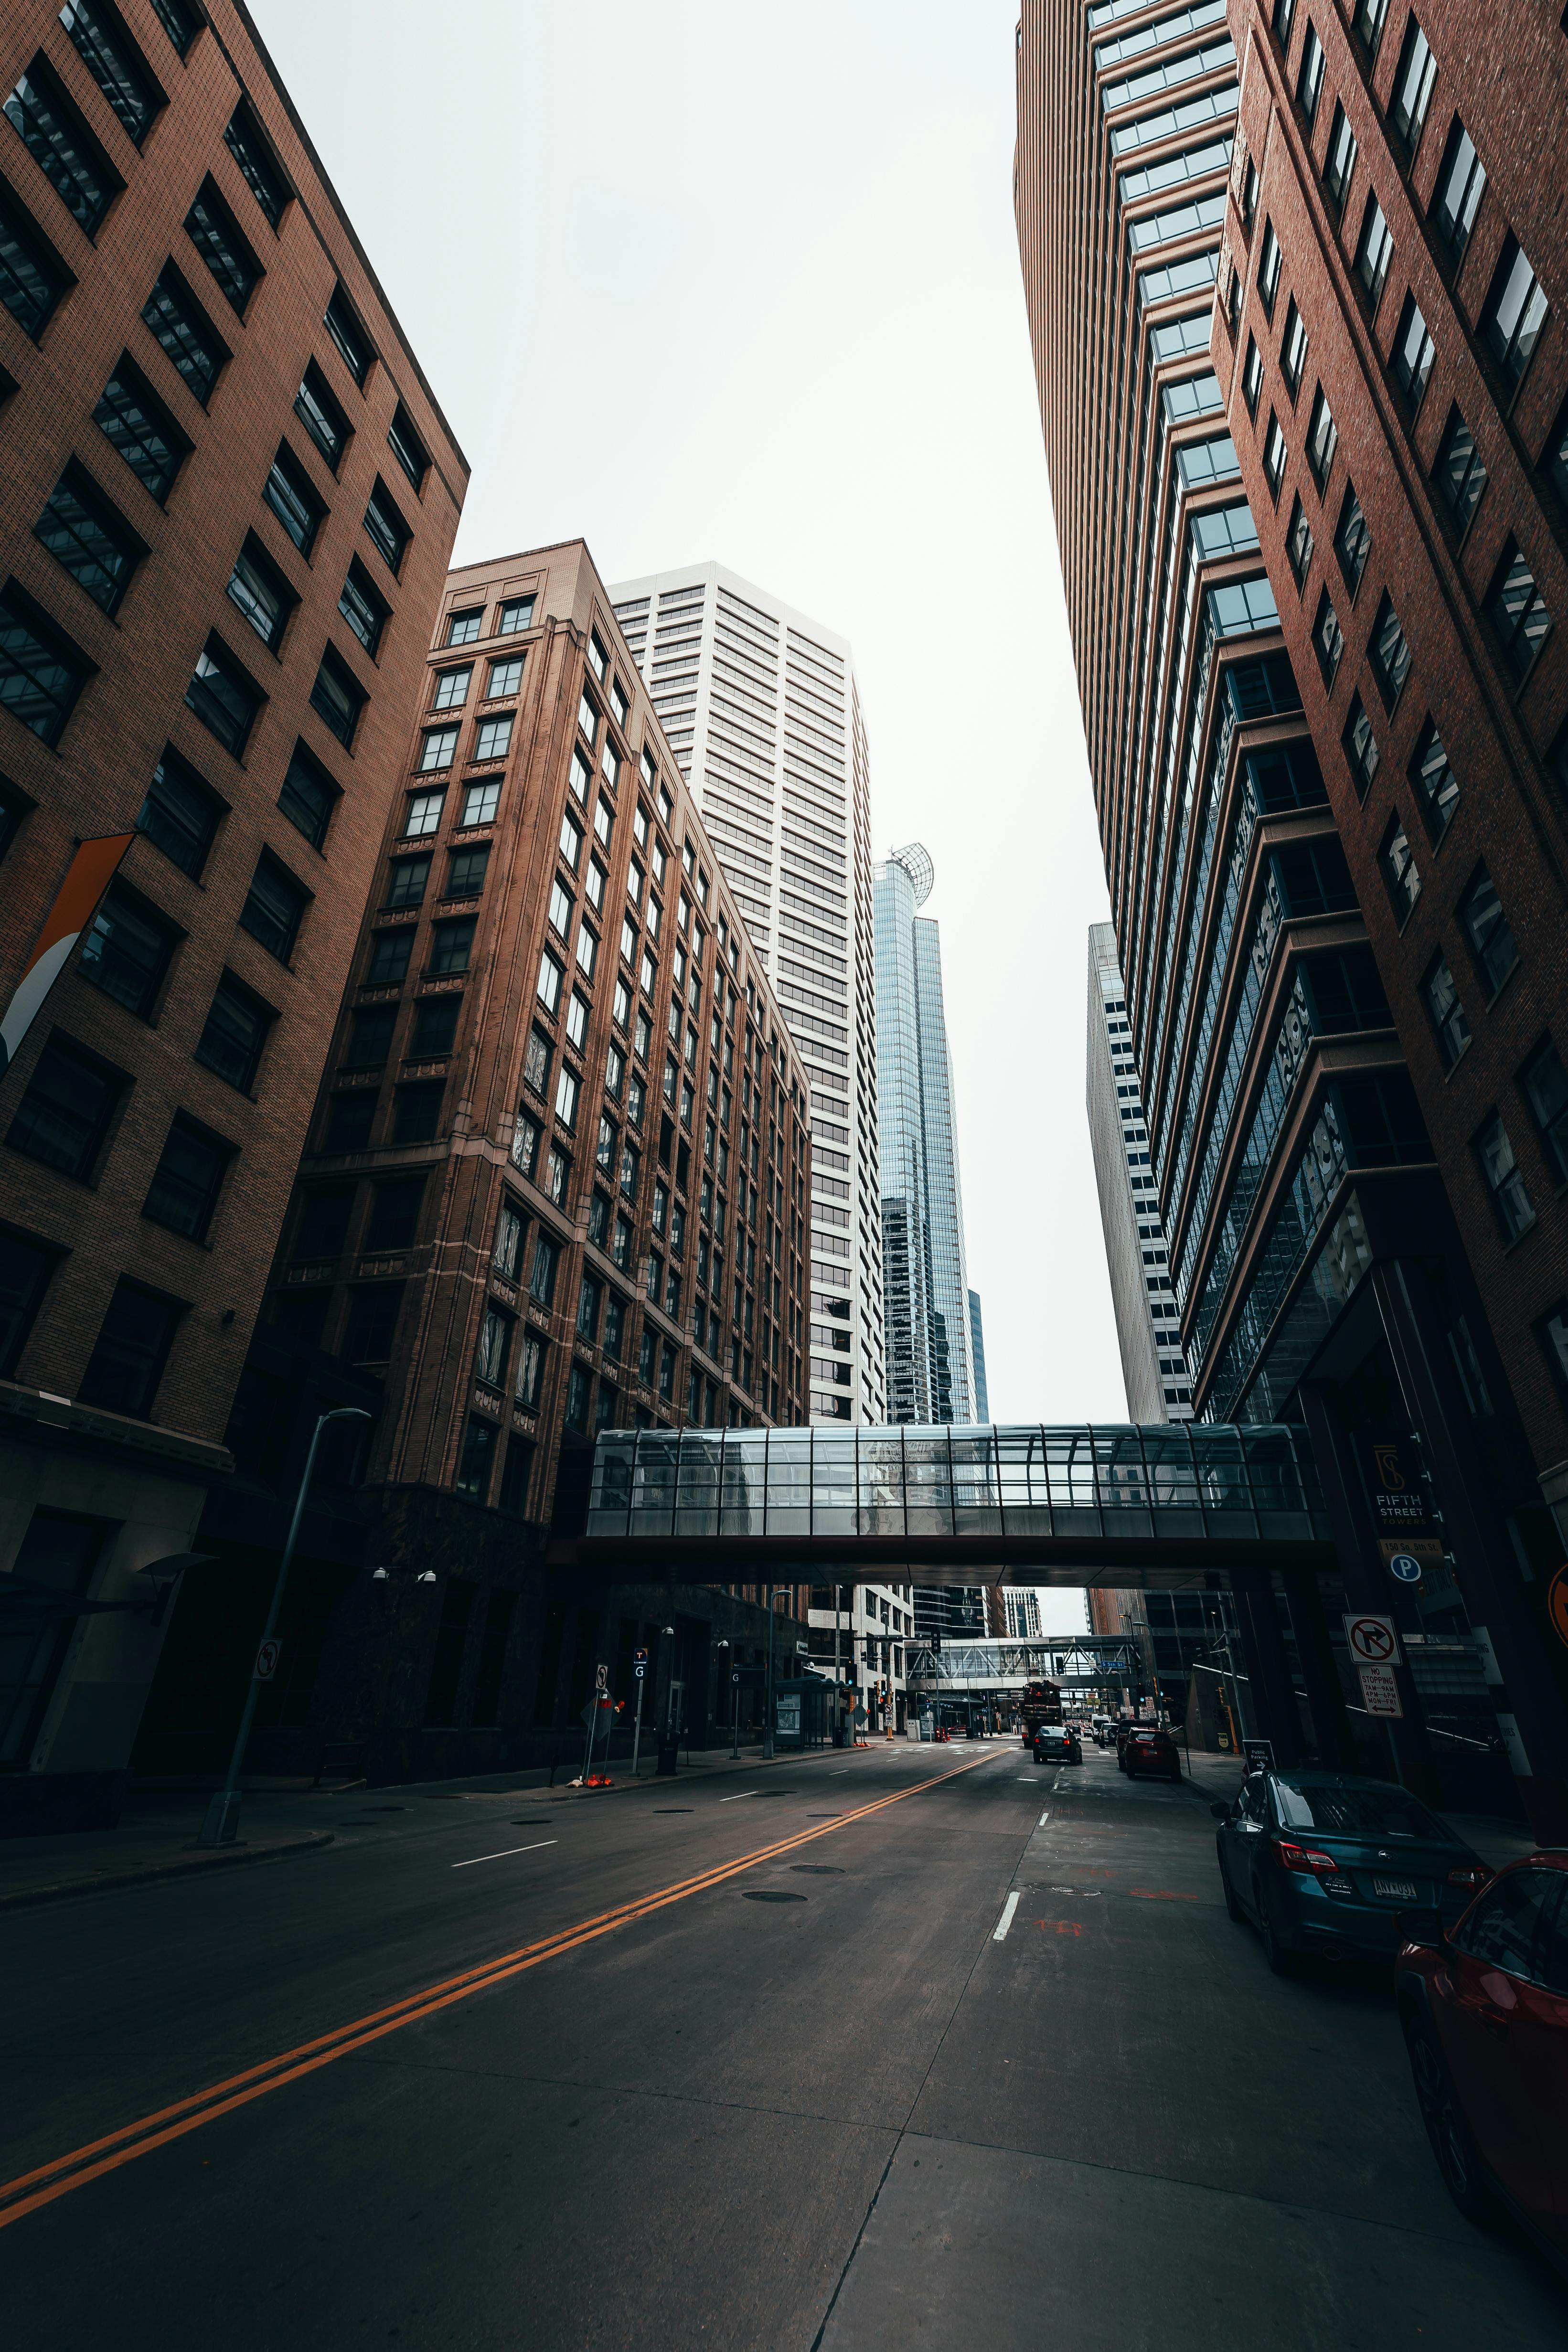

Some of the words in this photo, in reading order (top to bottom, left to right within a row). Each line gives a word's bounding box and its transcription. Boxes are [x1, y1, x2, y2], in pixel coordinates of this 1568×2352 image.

[1376, 1495, 1421, 1505] FIFTH
[1385, 1543, 1399, 1551] 150
[1429, 1543, 1439, 1551] St.
[1399, 1559, 1412, 1576] P
[1435, 1566, 1453, 1592] ONLY
[635, 1666, 644, 1677] G
[1362, 1675, 1393, 1684] STOPPING
